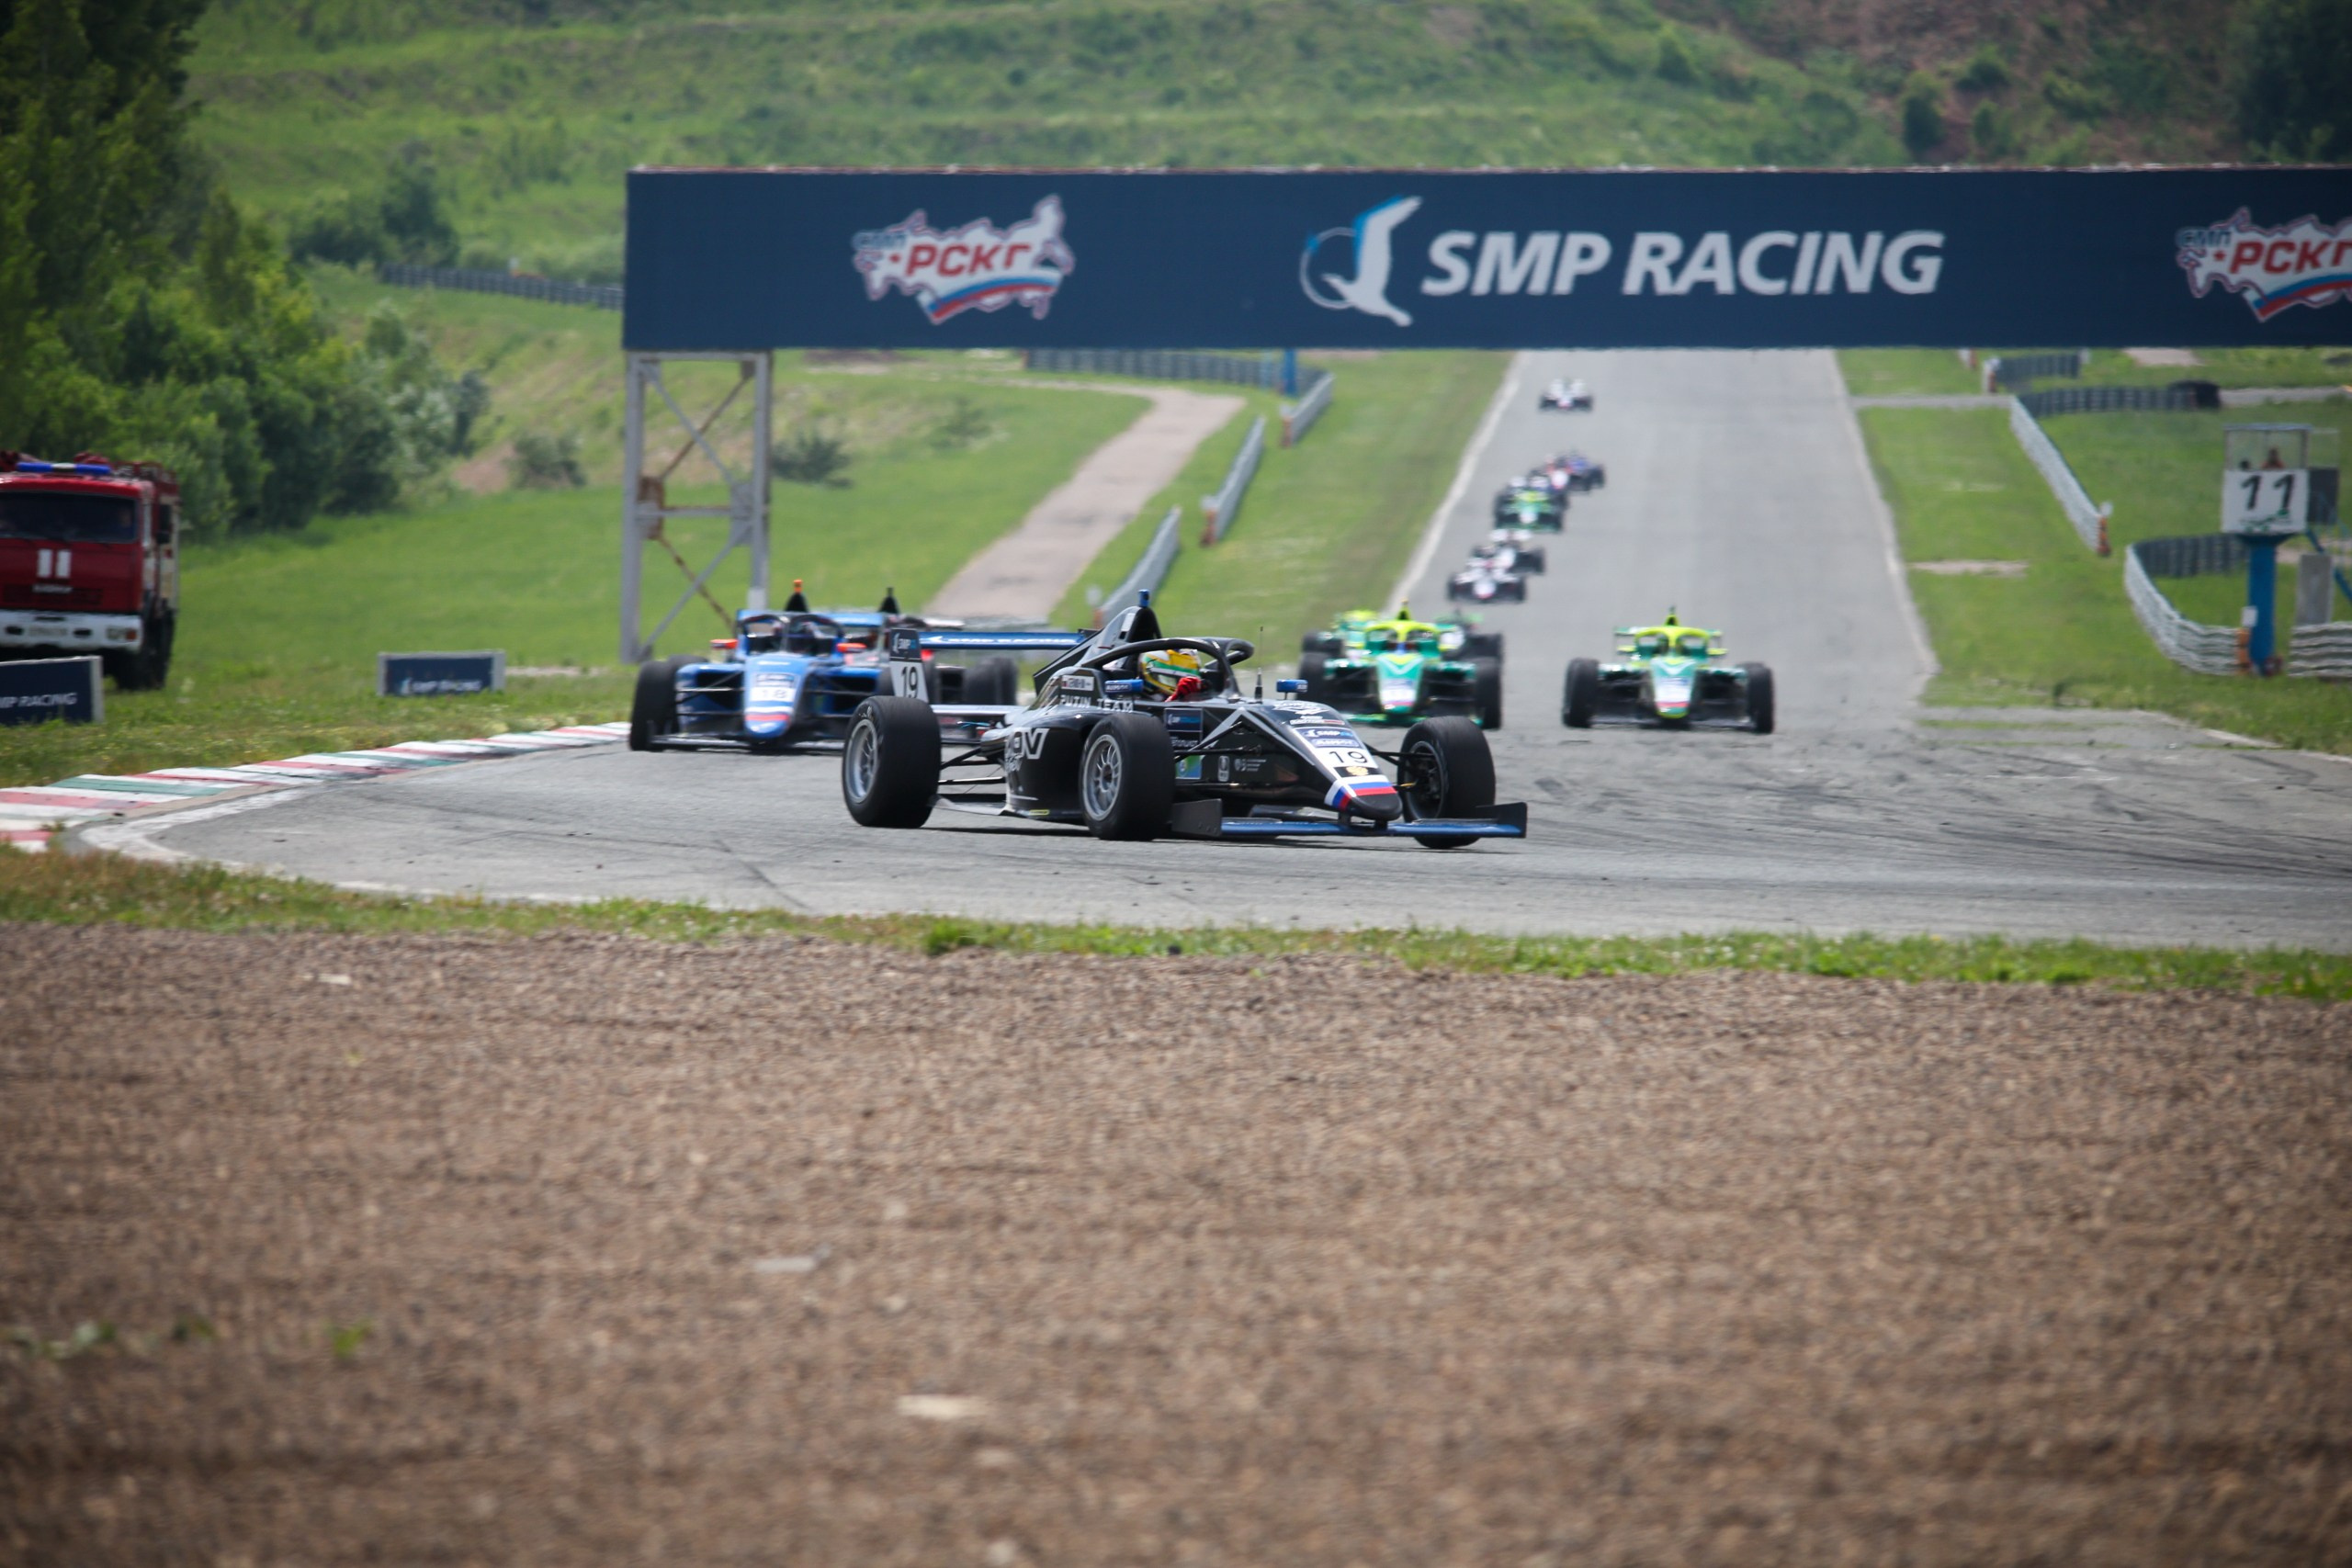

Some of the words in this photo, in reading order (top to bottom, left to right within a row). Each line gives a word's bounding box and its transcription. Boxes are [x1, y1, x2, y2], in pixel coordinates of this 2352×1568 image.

[905, 243, 1032, 276] РСКГ
[1421, 230, 1611, 296] SMP
[1622, 230, 1946, 296] RACING
[2241, 473, 2295, 511] 11
[900, 666, 919, 698] 19
[18, 693, 78, 707] RACING
[1097, 698, 1134, 713] TEAM
[1329, 750, 1369, 764] 19
